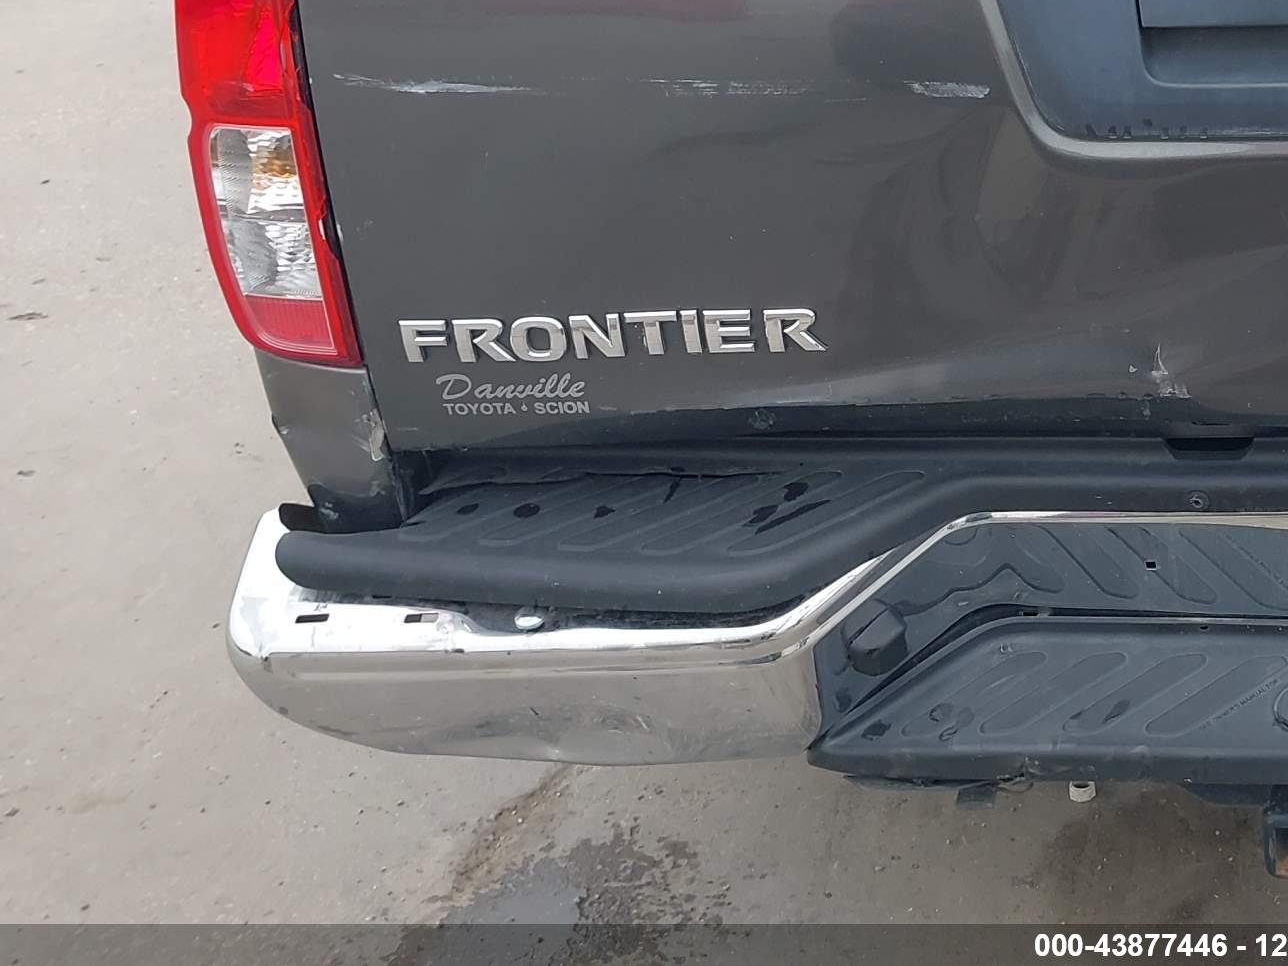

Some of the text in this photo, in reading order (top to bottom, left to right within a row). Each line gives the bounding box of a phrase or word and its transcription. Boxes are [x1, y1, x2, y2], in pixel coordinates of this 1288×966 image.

[398, 307, 828, 364] FRONTIER
[435, 372, 586, 401] Danville
[443, 401, 590, 416] TOYOTA SCION
